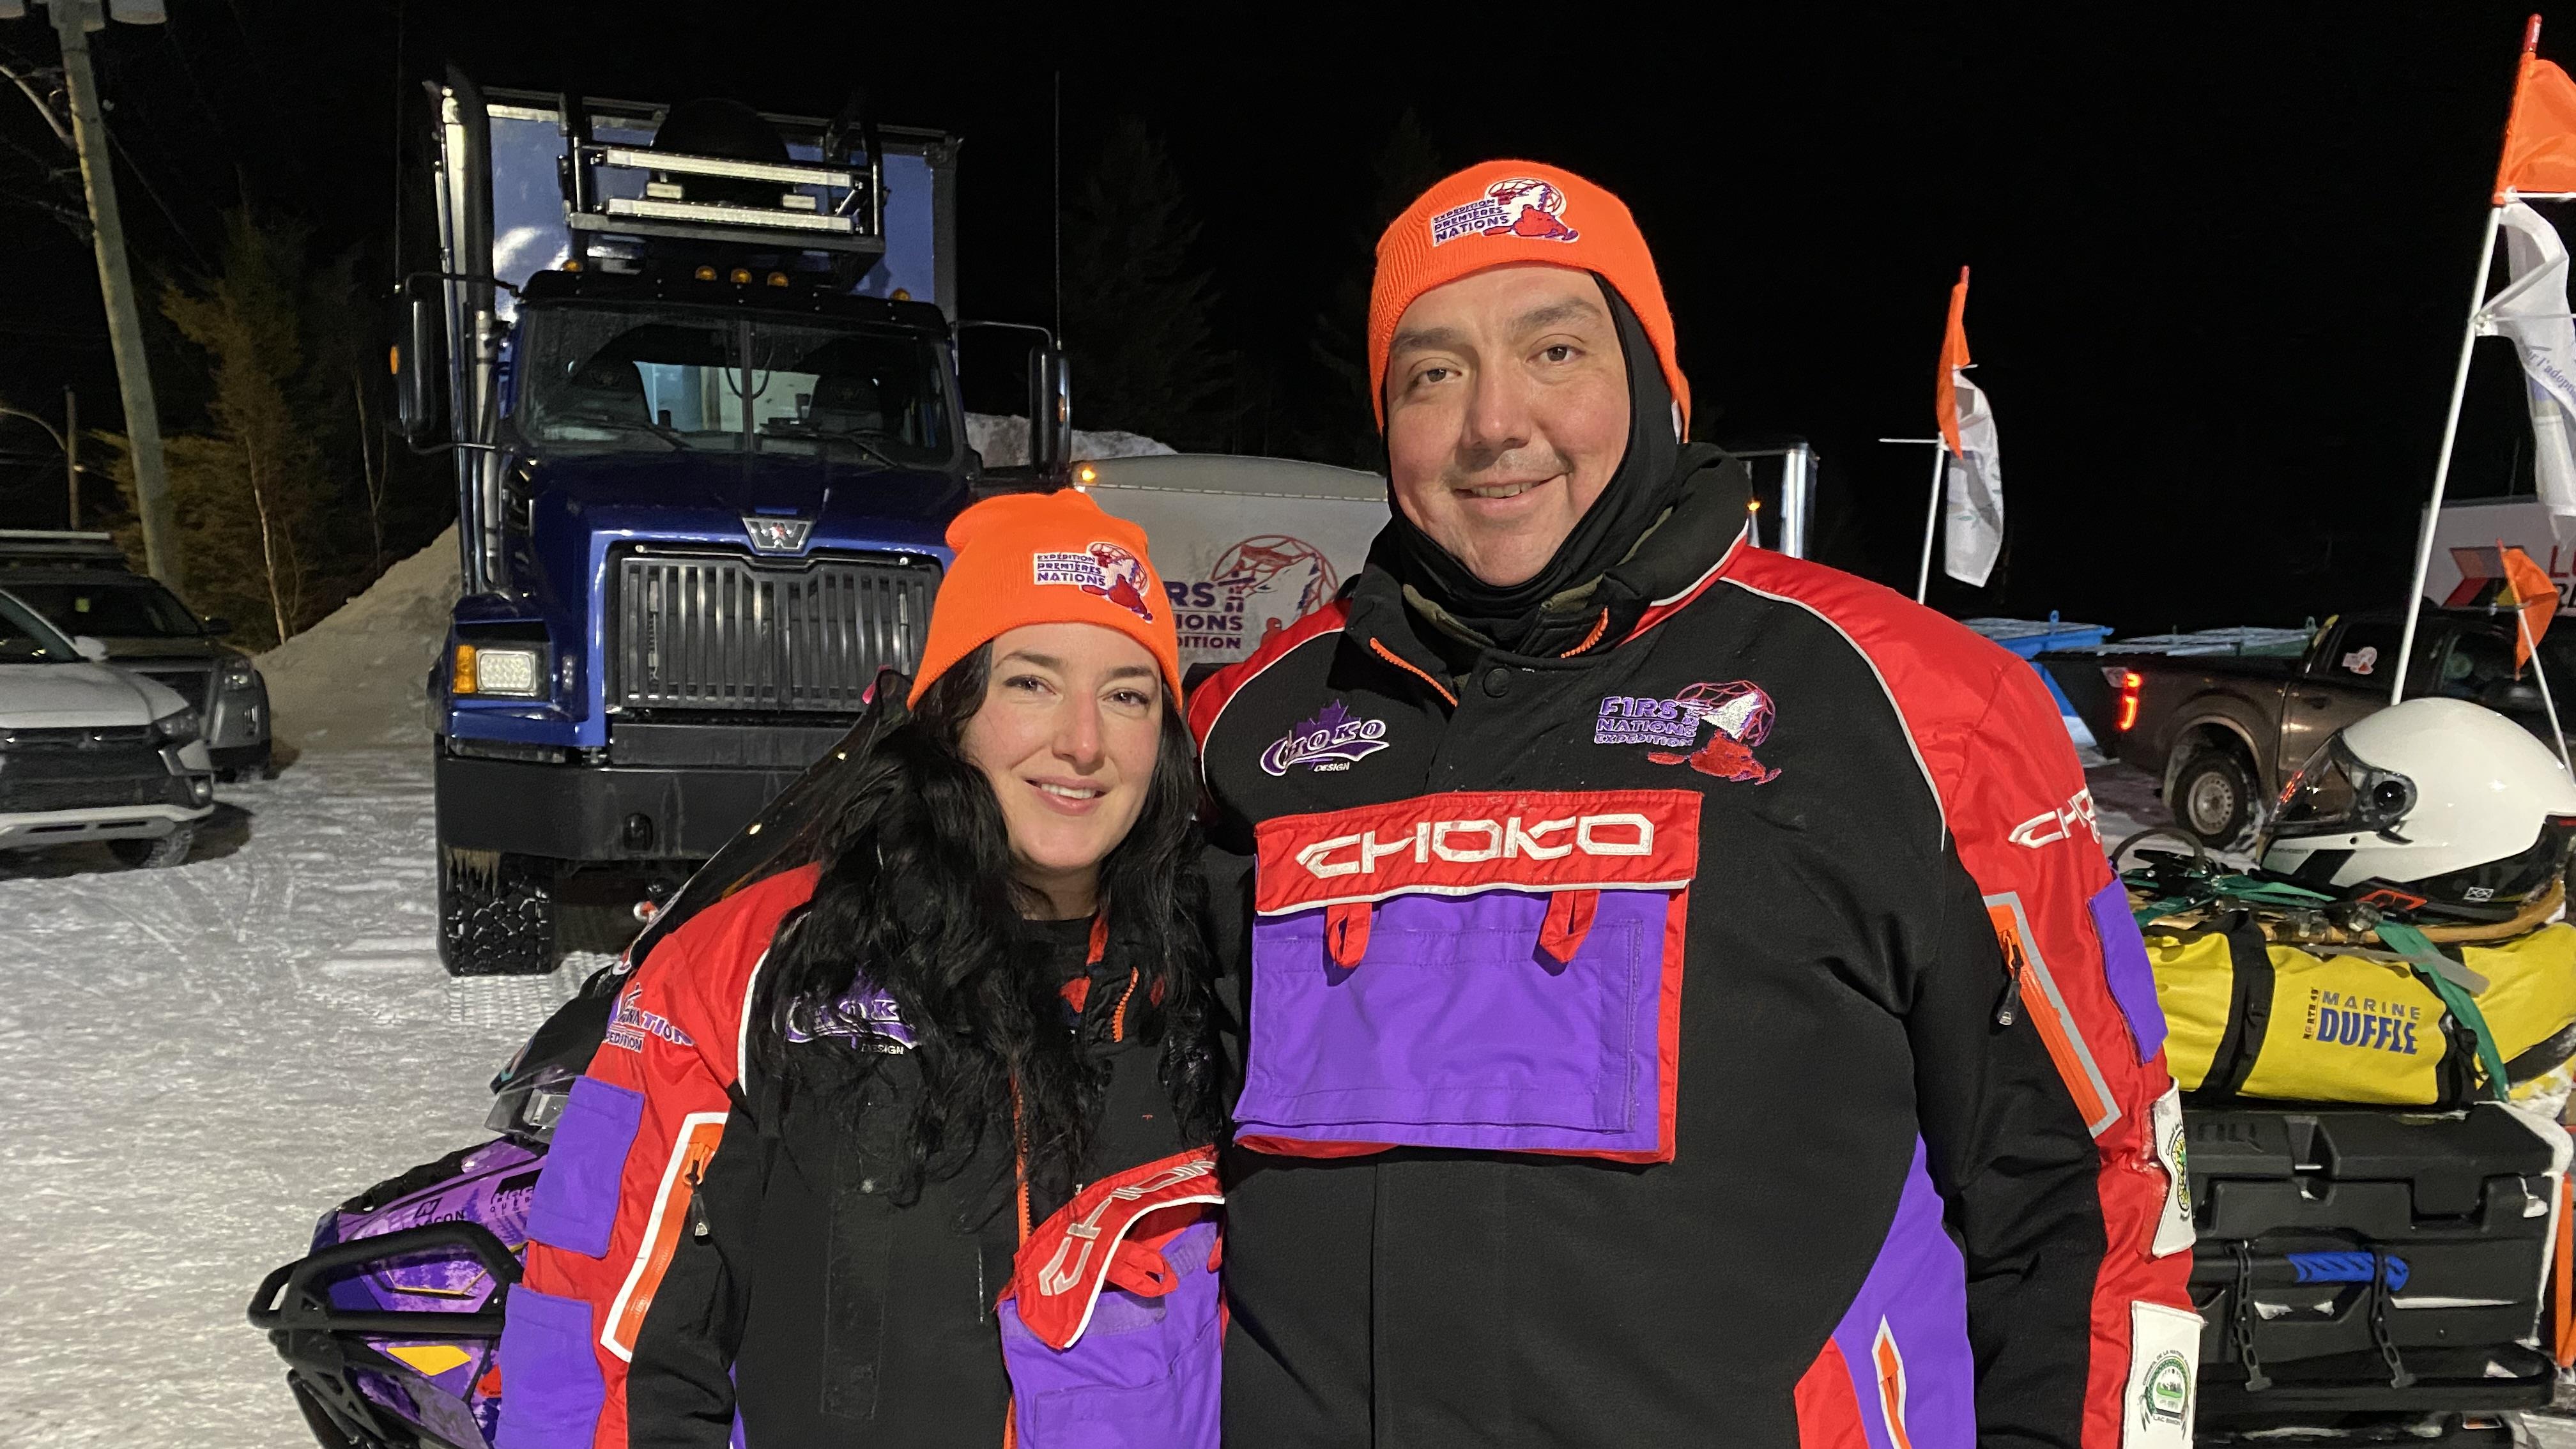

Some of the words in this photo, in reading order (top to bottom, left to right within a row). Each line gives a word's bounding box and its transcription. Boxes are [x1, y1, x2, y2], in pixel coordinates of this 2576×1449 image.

[1436, 215, 1509, 243] NATIONS
[1038, 572, 1106, 586] NATIONS
[1597, 717, 1697, 737] NATIONS
[1314, 762, 1350, 772] DESIGN
[1295, 813, 1654, 879] CHOKO
[2322, 991, 2421, 1020] MARINE
[2317, 1007, 2418, 1055] DUFFLE
[1038, 1160, 1216, 1296] CHOK
